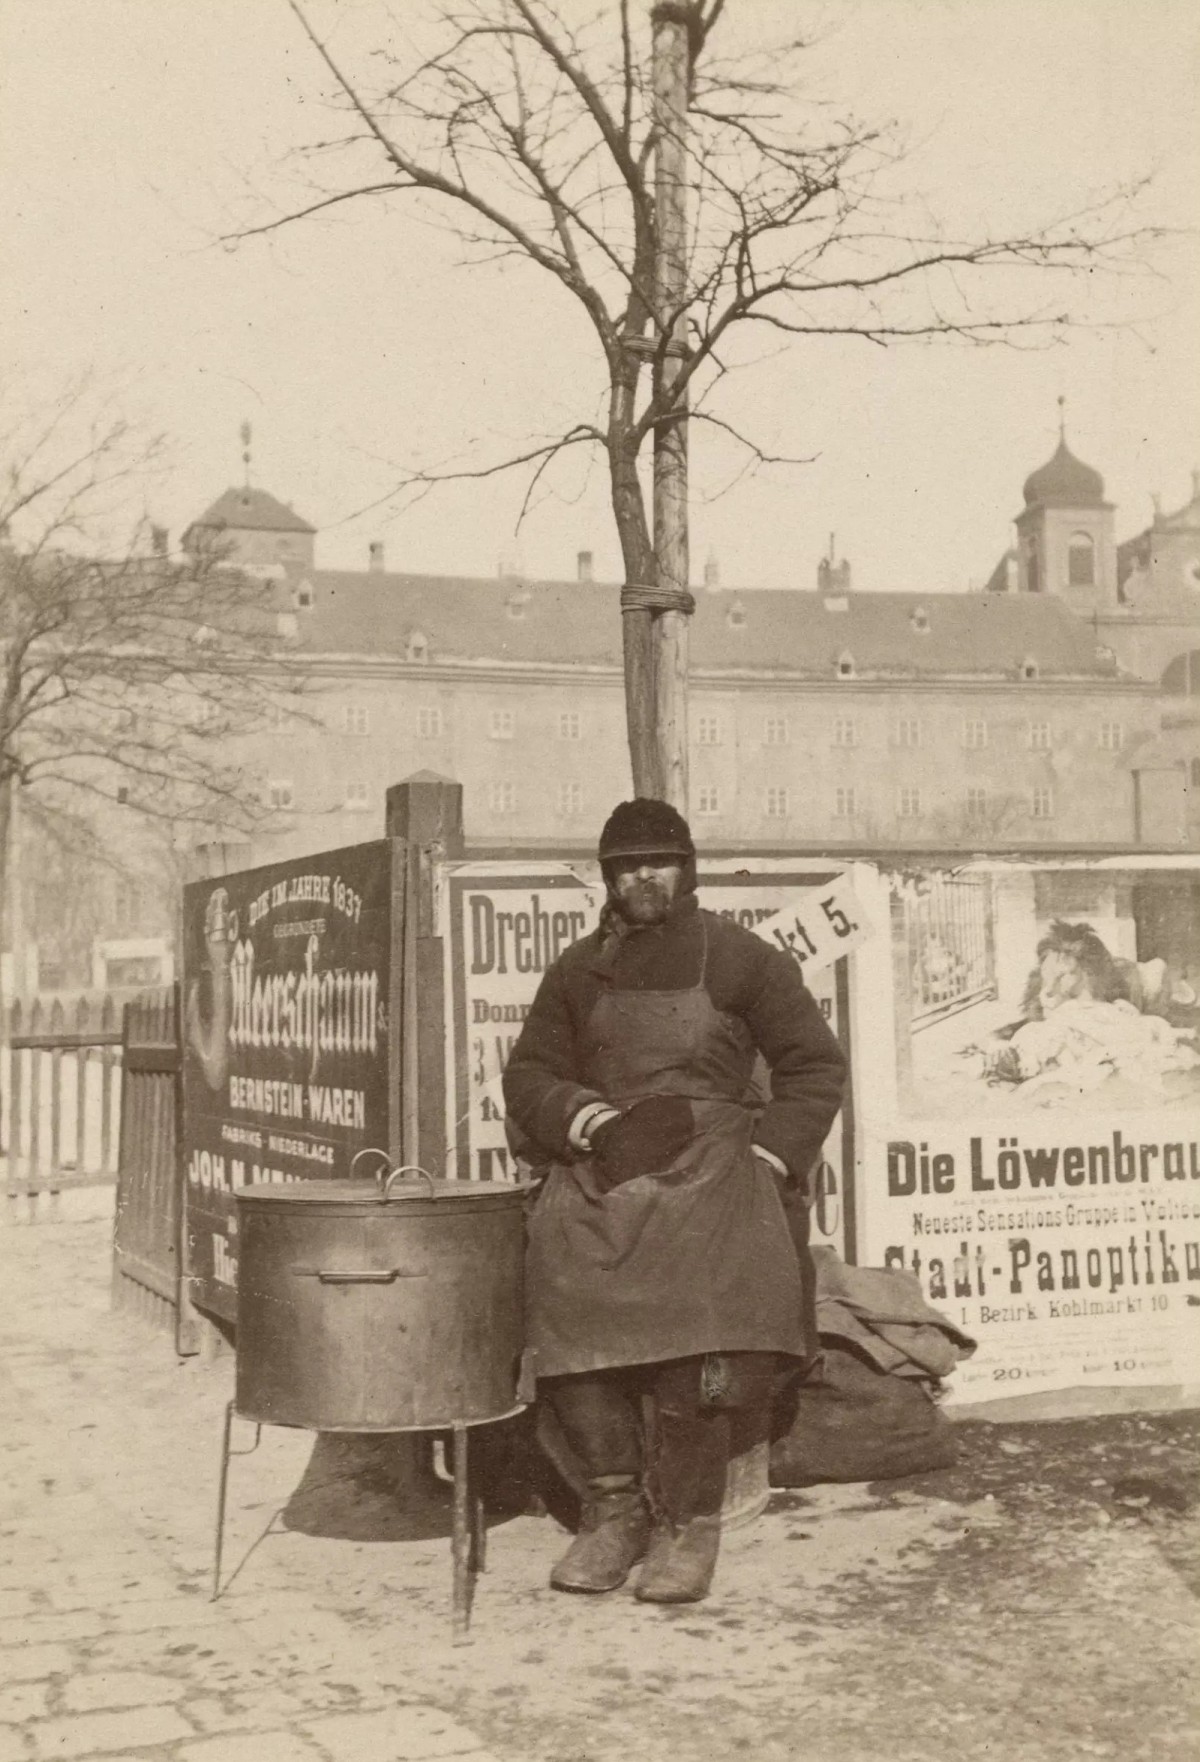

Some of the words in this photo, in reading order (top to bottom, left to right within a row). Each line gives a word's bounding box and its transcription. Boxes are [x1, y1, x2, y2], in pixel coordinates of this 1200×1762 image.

[288, 875, 331, 904] JAHRE
[229, 1075, 366, 1130] BERNSTEIN-WAREN
[887, 1141, 956, 1197] Die
[913, 1212, 973, 1237] Neueste
[977, 1203, 1062, 1233] Sensations
[1065, 1203, 1119, 1228] Gruppe
[1122, 1206, 1138, 1224] in
[979, 1302, 1038, 1325] Bezirk
[1048, 1296, 1143, 1318] Kohlmarkt
[1150, 1294, 1169, 1312] 10
[992, 1367, 1022, 1381] 20
[1113, 1359, 1136, 1372] 10
